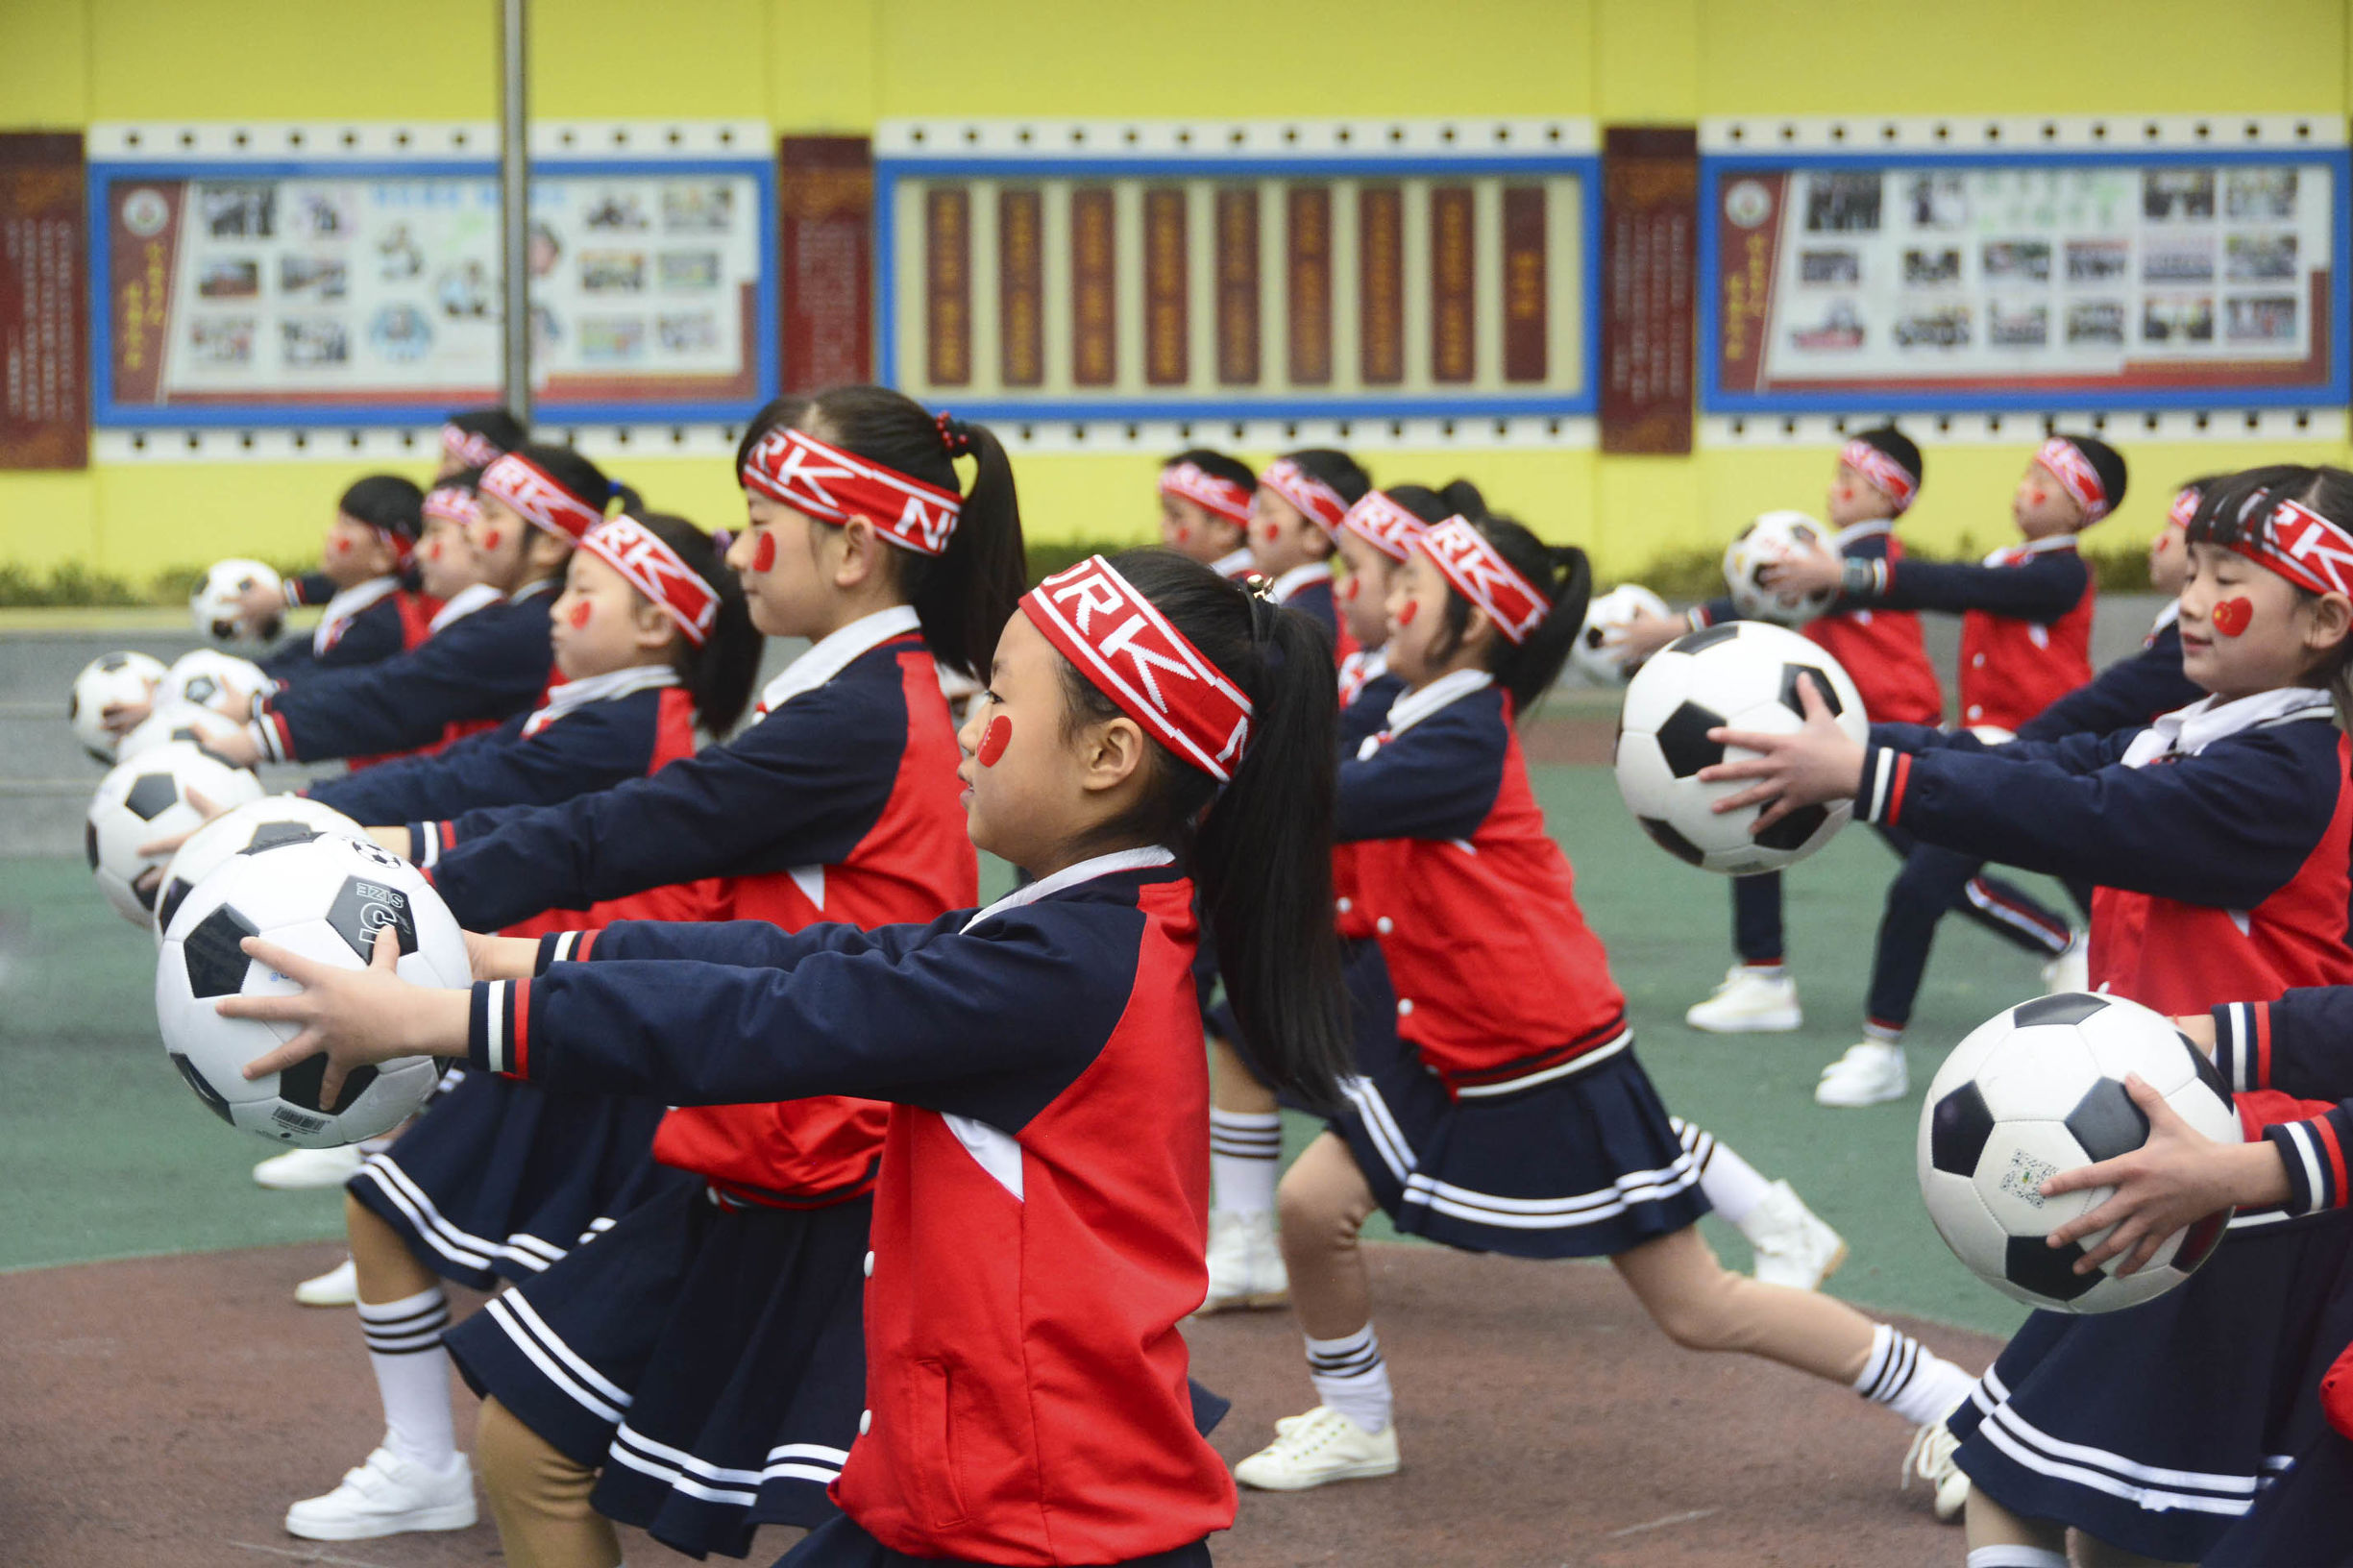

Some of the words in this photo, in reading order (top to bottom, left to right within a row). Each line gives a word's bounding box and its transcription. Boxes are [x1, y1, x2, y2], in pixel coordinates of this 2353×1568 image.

[593, 520, 685, 597] RK
[1431, 526, 1511, 601] RK
[356, 882, 404, 908] SIZE
